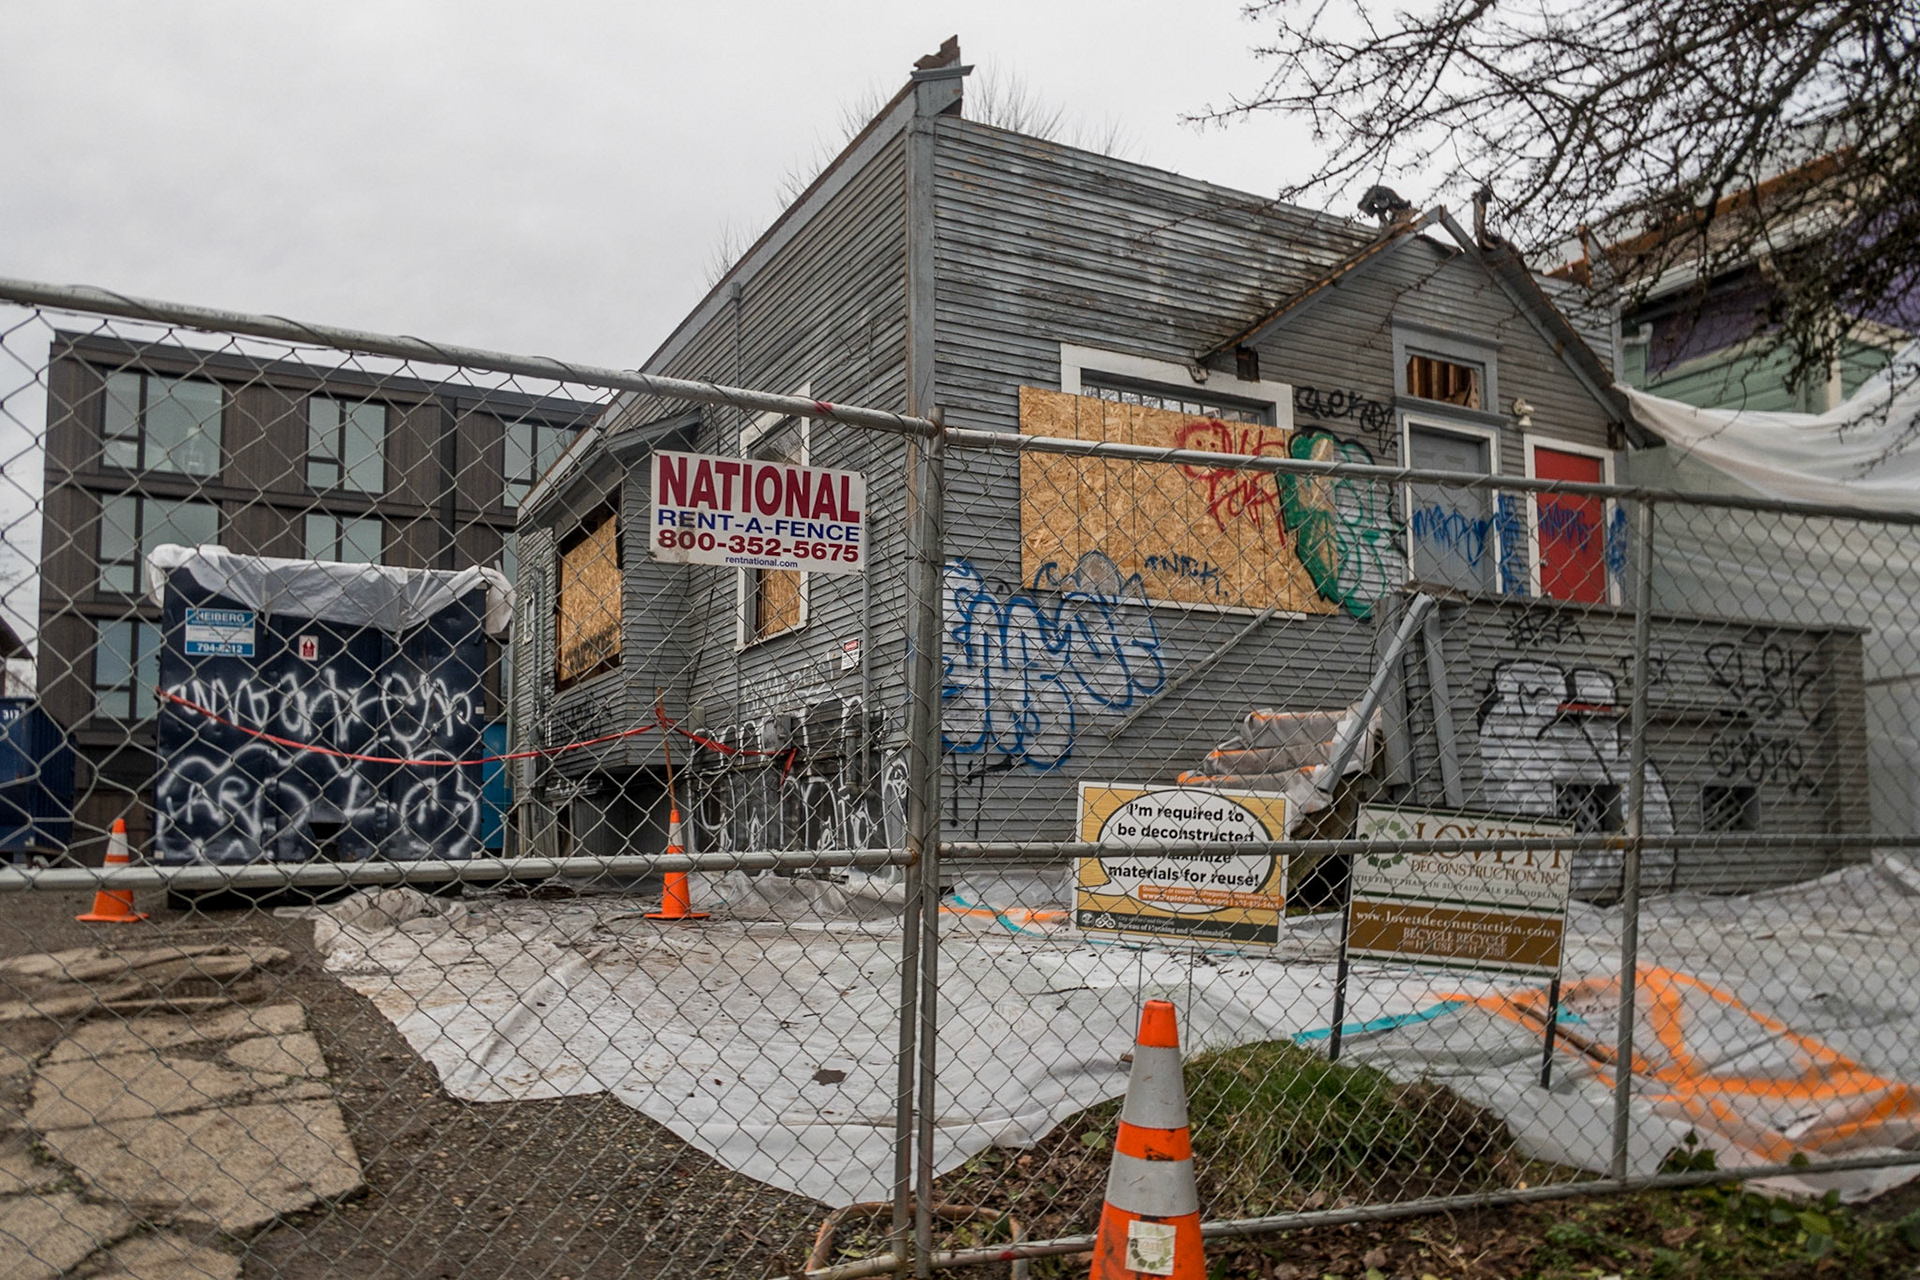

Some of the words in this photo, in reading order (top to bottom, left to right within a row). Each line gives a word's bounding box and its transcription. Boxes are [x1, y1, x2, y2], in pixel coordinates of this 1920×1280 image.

[659, 455, 861, 524] NATIONAL
[658, 509, 860, 542] RENT-A-FENCE
[658, 529, 859, 563] 800-352-5675
[725, 556, 798, 568] rentnational.com
[1130, 804, 1152, 817] I'm
[1157, 806, 1223, 821] required
[1228, 809, 1244, 822] to
[1118, 823, 1136, 836] be
[1141, 825, 1254, 842] deconstructed
[1108, 864, 1180, 881] materials
[1184, 869, 1207, 883] for
[1211, 873, 1259, 887] reuse!
